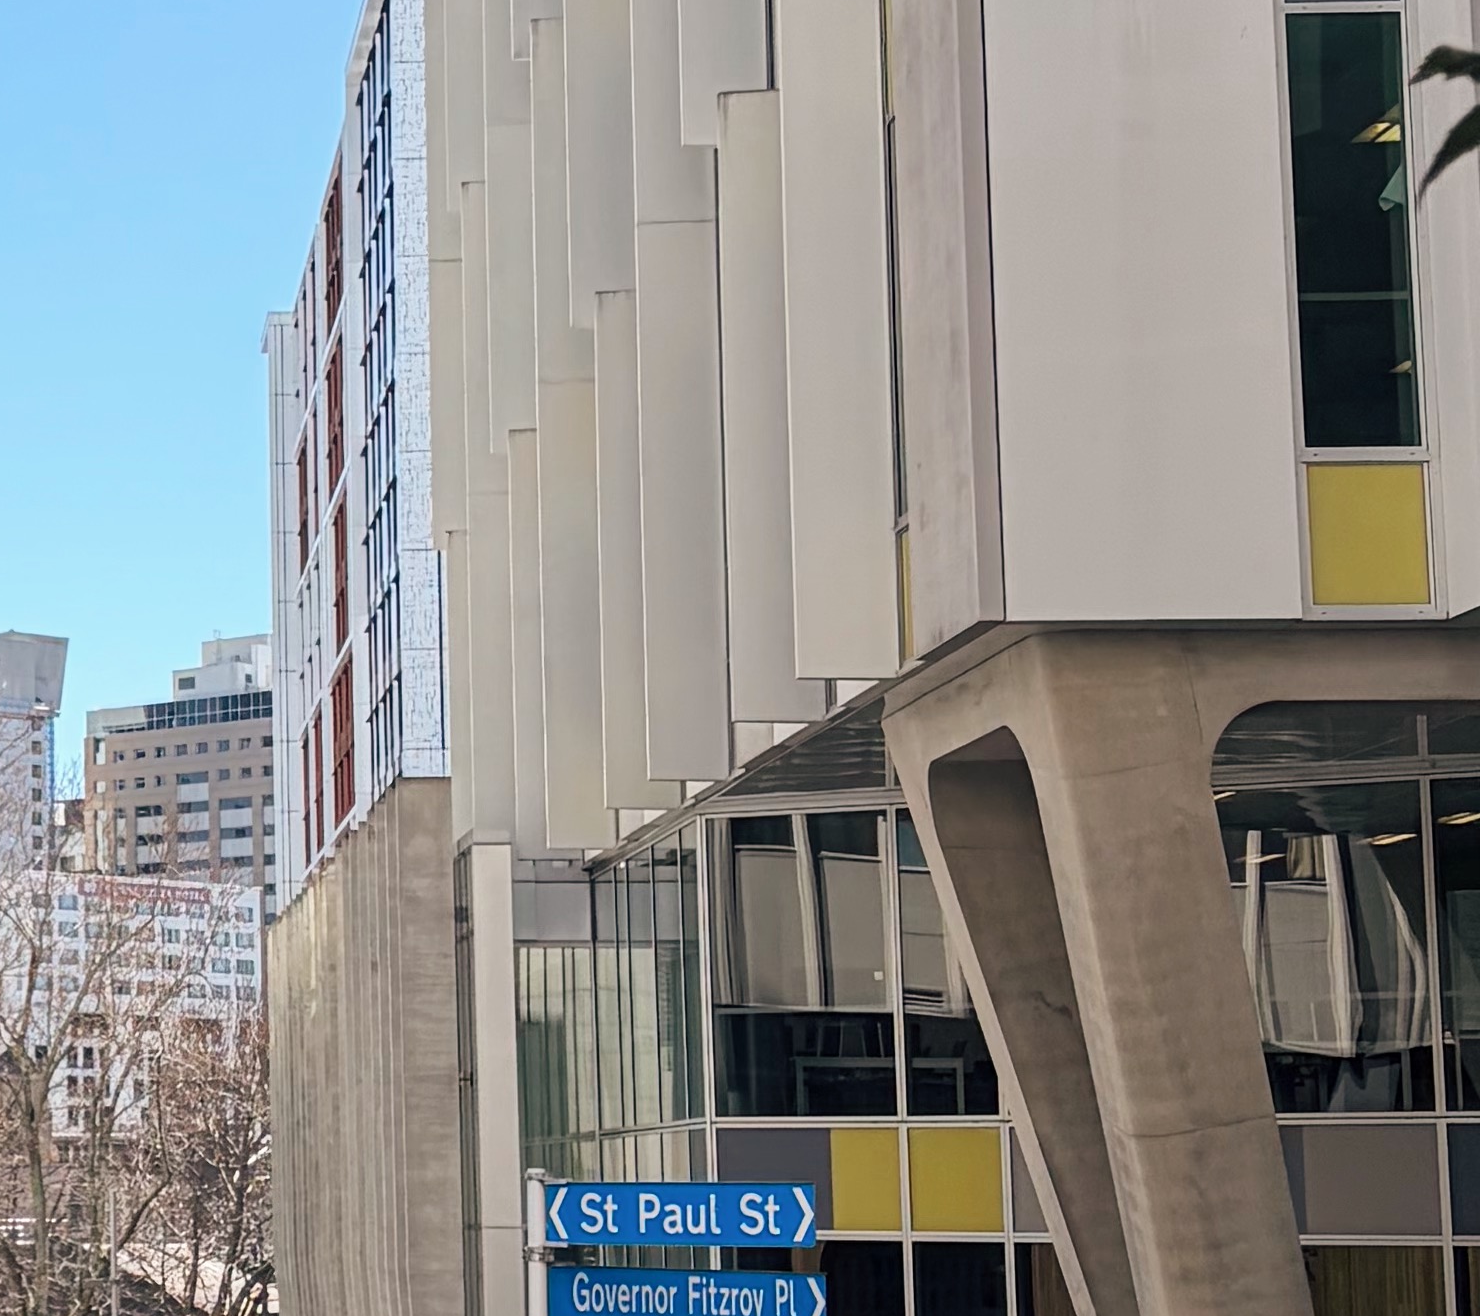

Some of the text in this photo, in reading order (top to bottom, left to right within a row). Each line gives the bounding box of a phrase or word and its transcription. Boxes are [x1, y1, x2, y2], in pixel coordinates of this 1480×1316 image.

[580, 1192, 781, 1235] St Paul St
[572, 1271, 678, 1316] Governor
